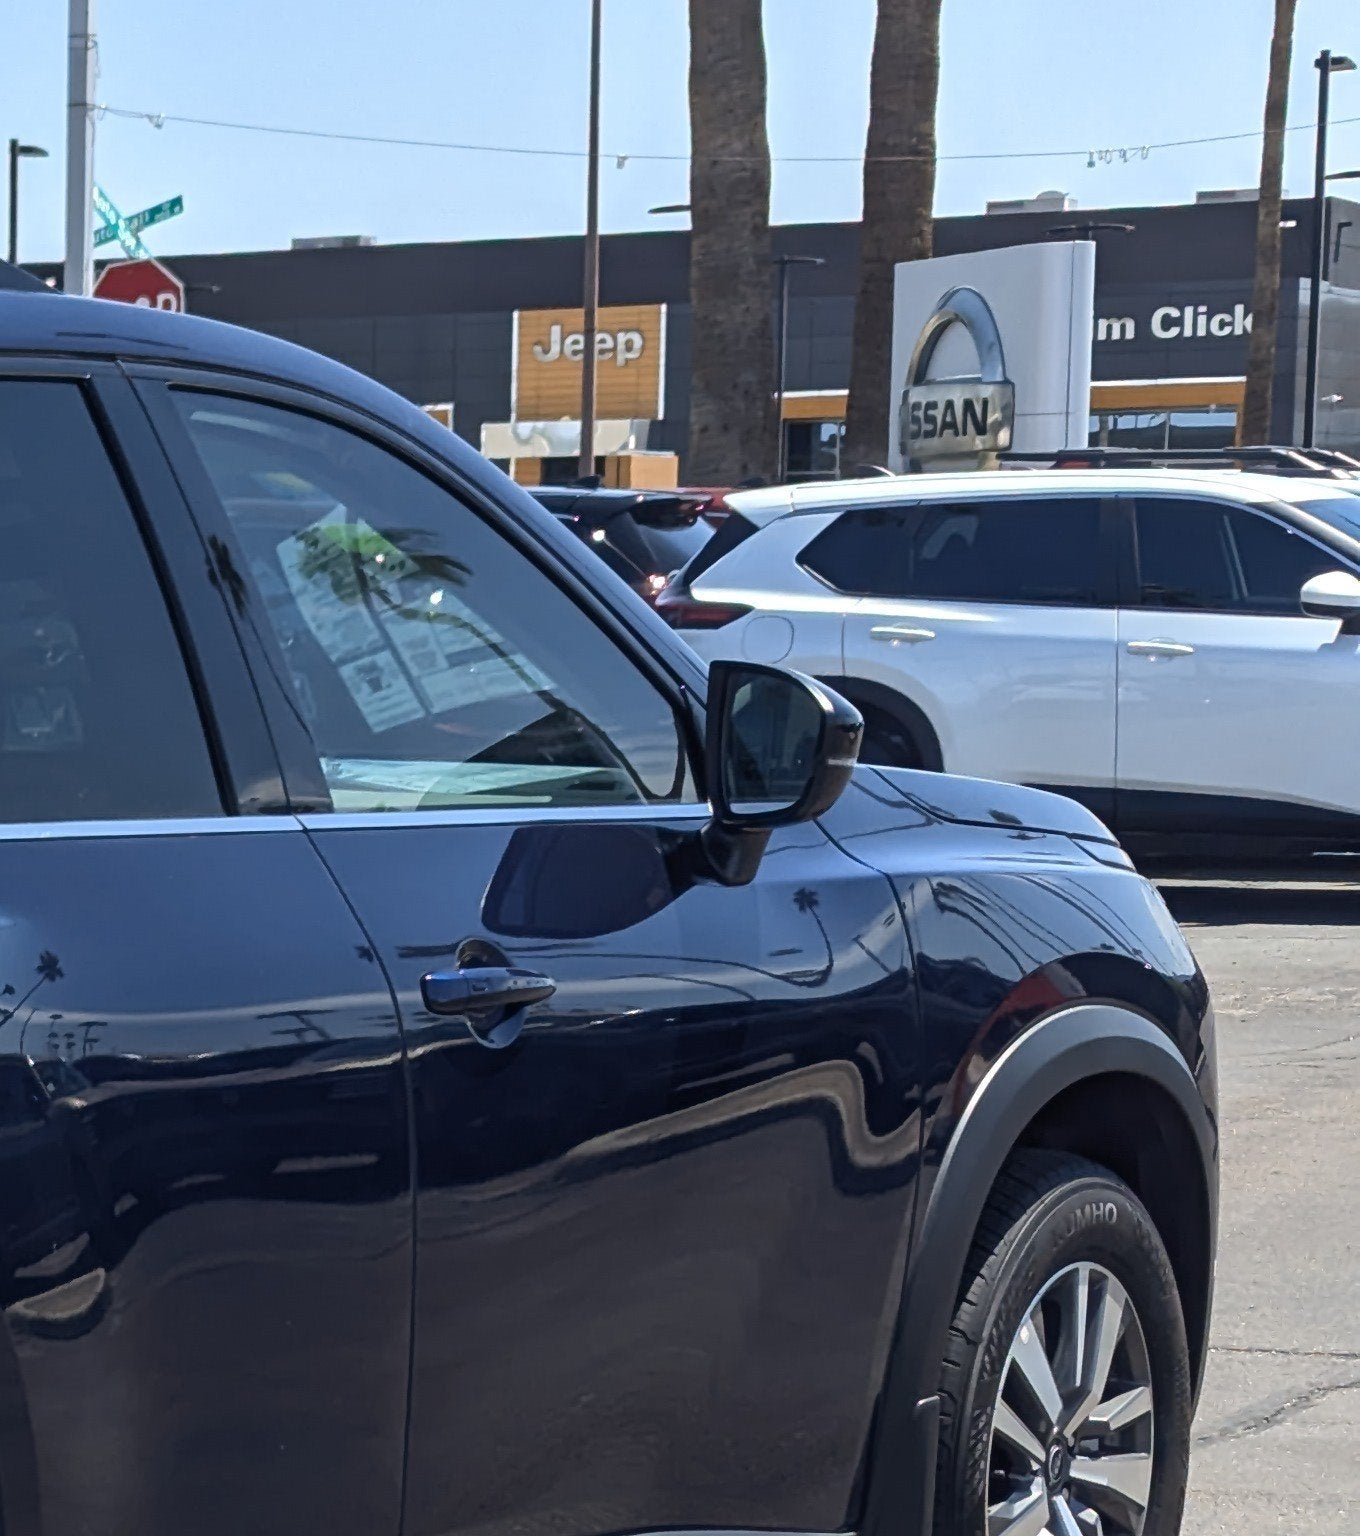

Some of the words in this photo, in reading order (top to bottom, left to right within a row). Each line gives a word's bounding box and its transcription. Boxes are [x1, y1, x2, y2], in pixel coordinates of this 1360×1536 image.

[1151, 303, 1254, 339] Click
[532, 324, 644, 367] Jeep
[910, 397, 989, 440] SSAN
